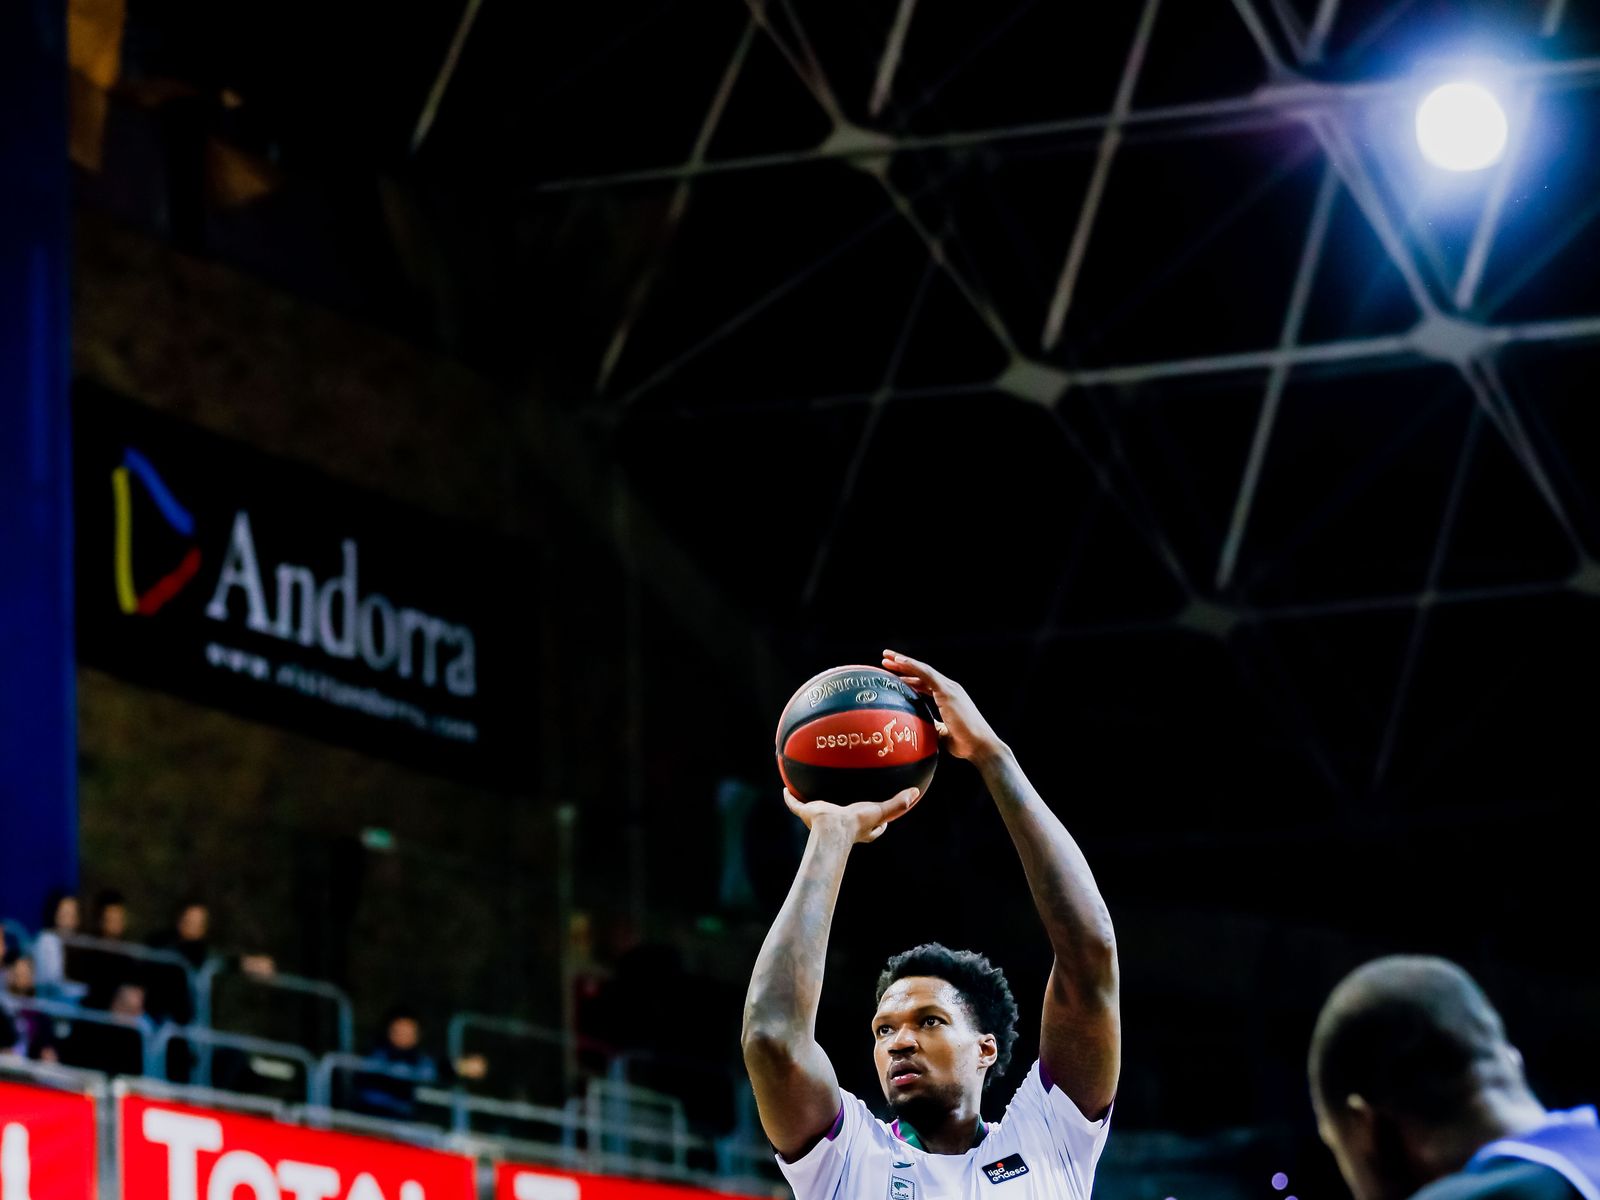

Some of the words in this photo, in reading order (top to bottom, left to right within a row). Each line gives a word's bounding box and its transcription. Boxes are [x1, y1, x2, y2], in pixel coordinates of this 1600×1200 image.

[206, 510, 477, 696] Andorra
[815, 730, 884, 750] endesa
[988, 1165, 1005, 1177] liga
[992, 1165, 1027, 1182] endesa
